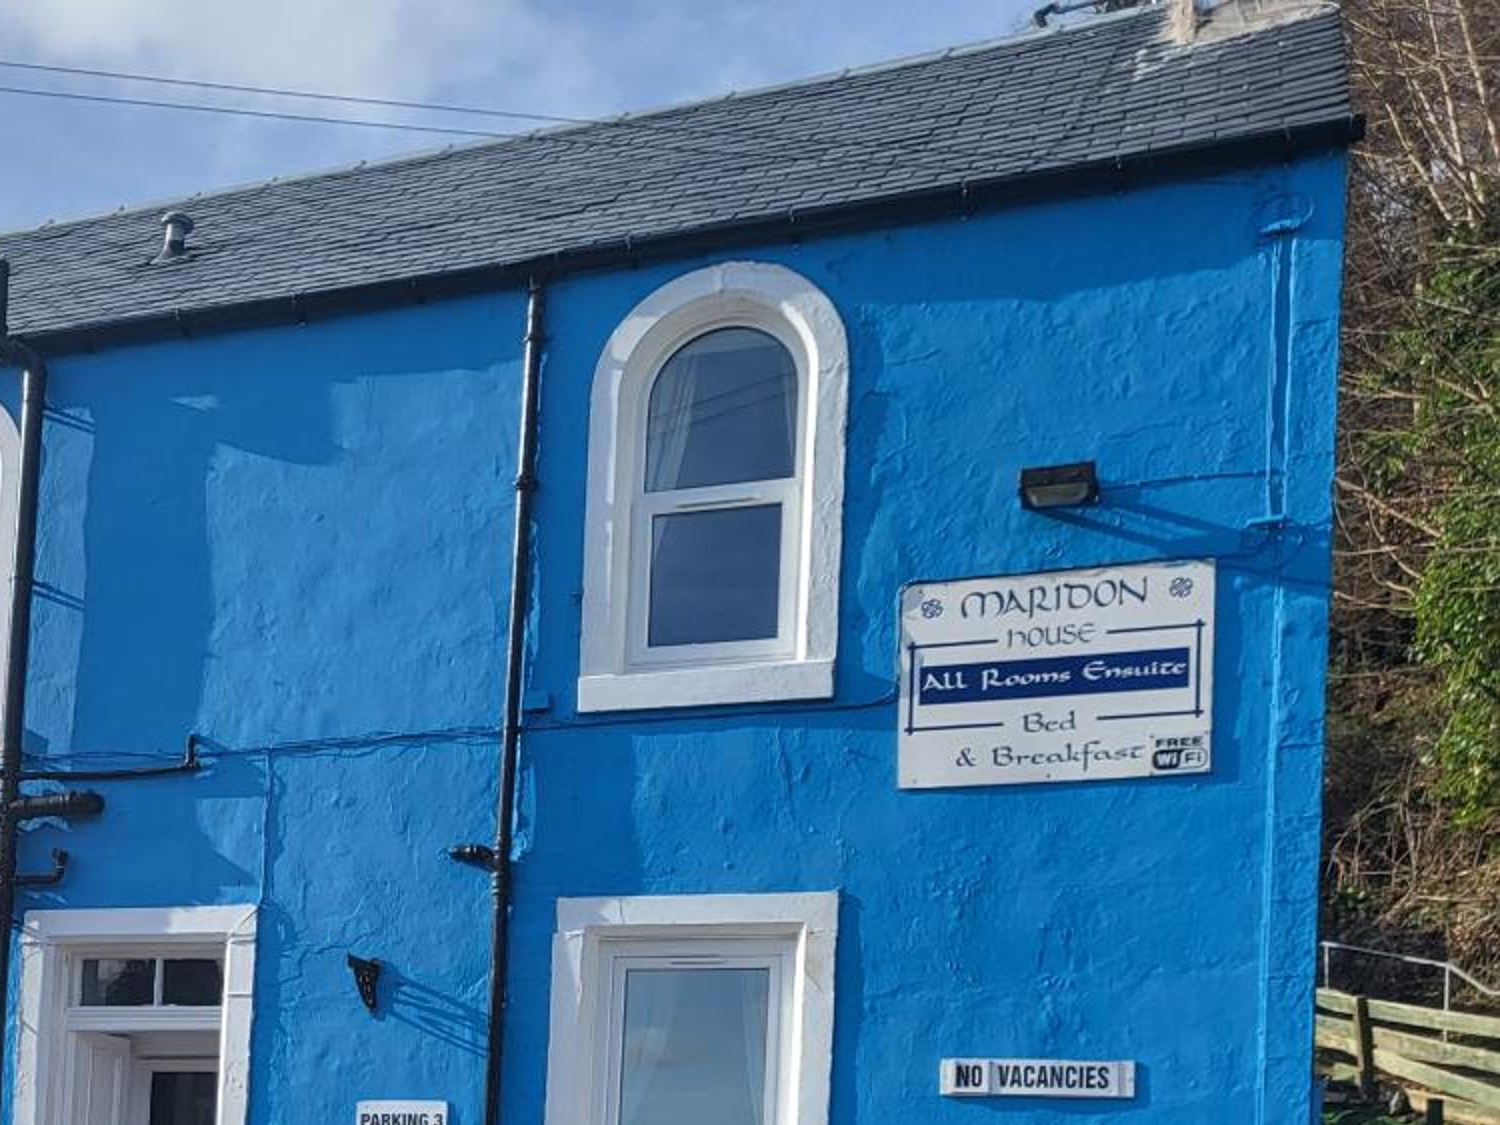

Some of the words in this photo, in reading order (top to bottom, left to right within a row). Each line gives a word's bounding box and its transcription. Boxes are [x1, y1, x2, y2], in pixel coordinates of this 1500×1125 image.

[960, 577, 1149, 619] MARIDON
[981, 666, 1071, 691] Rooms
[1082, 658, 1187, 679] Ensuite
[1022, 711, 1076, 734] Bed
[1155, 735, 1204, 748] FREE
[955, 748, 977, 767] &
[992, 741, 1144, 771] Breakfast
[955, 1065, 983, 1088] NO
[998, 1065, 1109, 1089] VACANCIES
